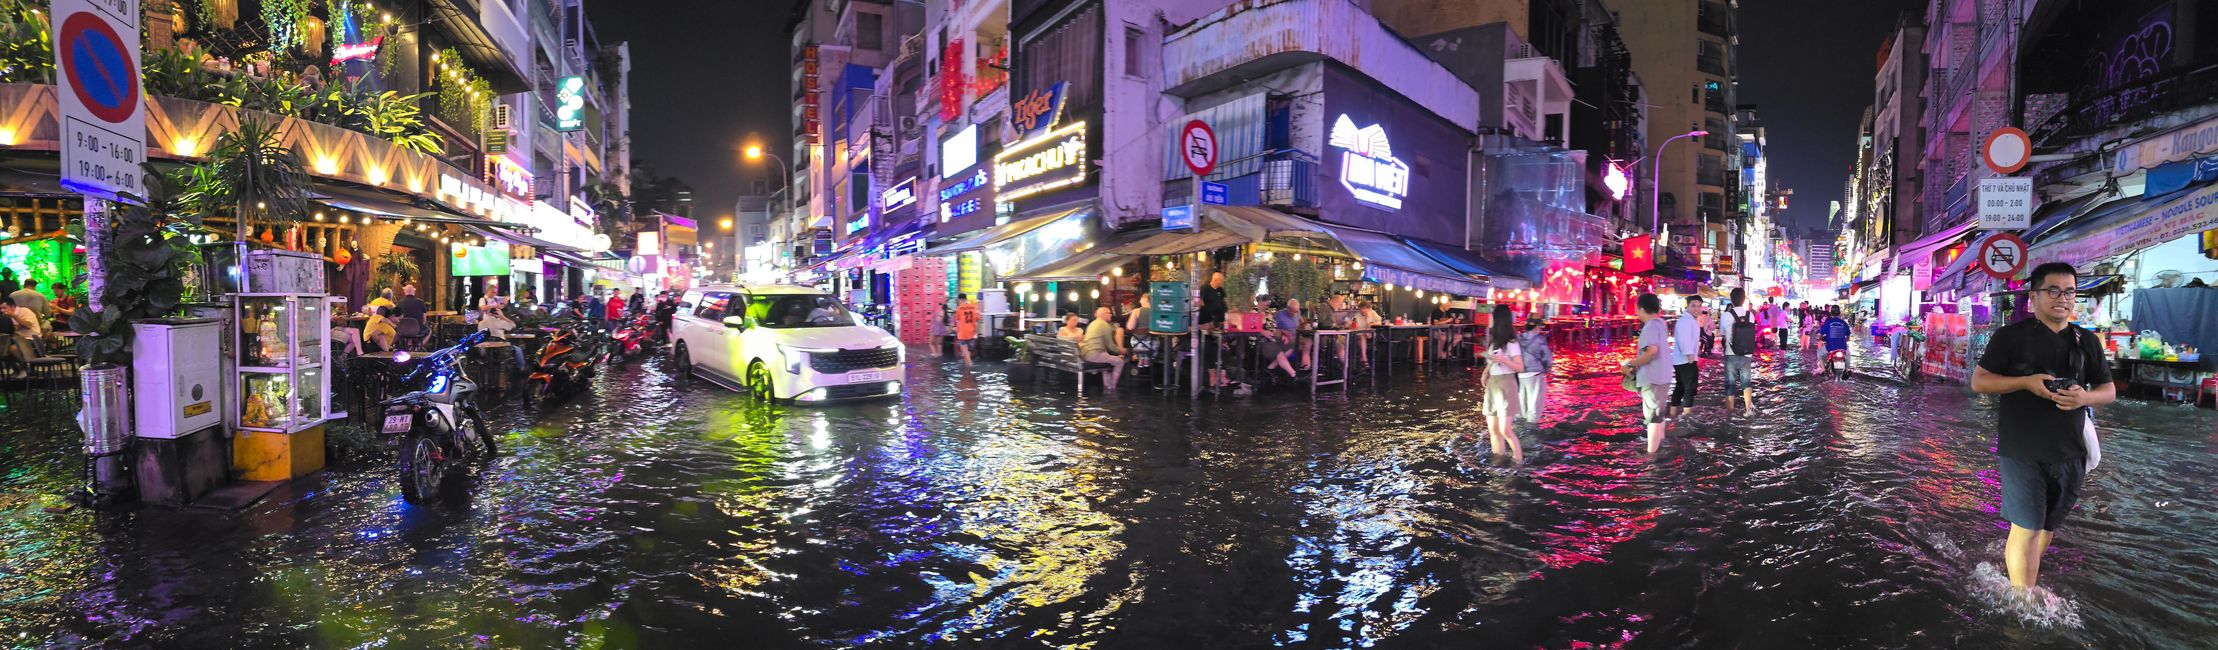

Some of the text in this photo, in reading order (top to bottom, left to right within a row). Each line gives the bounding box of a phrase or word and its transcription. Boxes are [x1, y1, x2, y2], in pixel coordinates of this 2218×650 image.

[807, 48, 816, 133] HOSTEL
[1014, 89, 1053, 130] Tiger
[77, 132, 98, 152] 9:00
[109, 142, 133, 163] 16:00
[79, 160, 105, 181] 19:00
[115, 170, 134, 189] 6:00
[2162, 200, 2193, 220] NOODLE
[1365, 263, 1396, 281] Little
